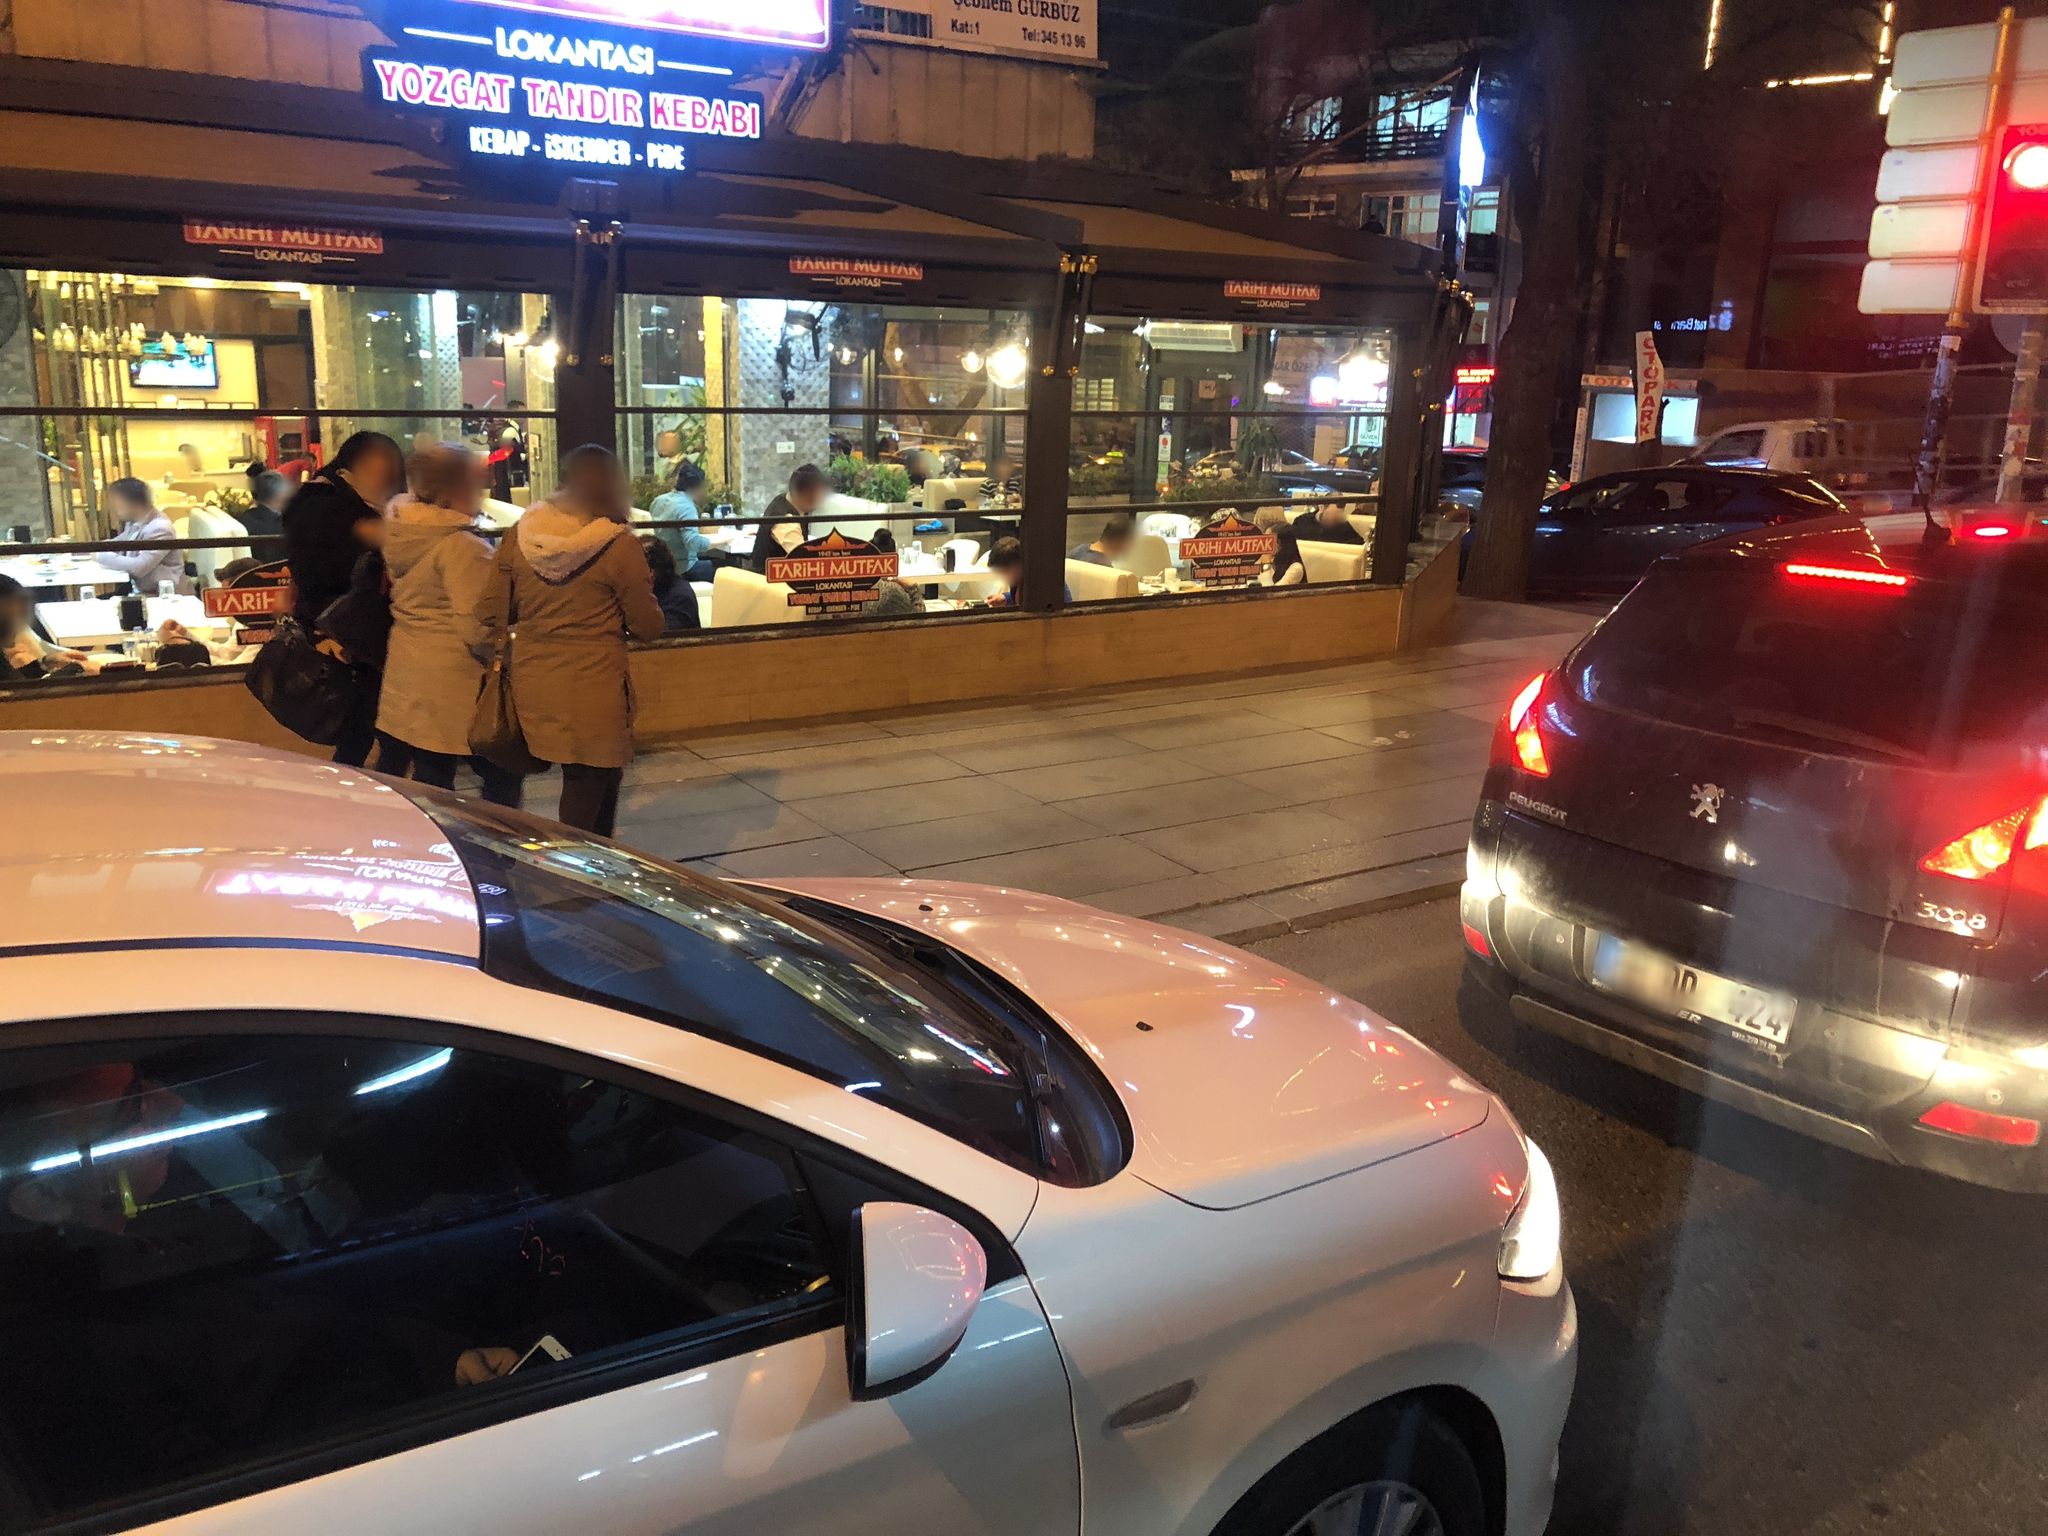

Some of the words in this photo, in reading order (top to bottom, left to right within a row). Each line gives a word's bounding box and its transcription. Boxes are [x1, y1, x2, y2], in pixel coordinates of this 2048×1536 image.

[1061, 34, 1073, 47] 13
[496, 27, 655, 76] LOKANTASI
[373, 59, 512, 113] YOZGAT
[522, 77, 644, 128] TANDIR
[649, 96, 761, 139] KEBABI
[469, 126, 531, 155] KEBAP
[254, 249, 323, 263] LOKANTASI
[853, 260, 920, 276] MUTFAK
[836, 276, 881, 287] LOKANTASI
[1270, 284, 1317, 297] MUTFAK
[1639, 337, 1659, 436] OTOPARK
[1225, 538, 1272, 554] MUTFAK
[830, 558, 894, 576] MUTFAK
[815, 582, 853, 591] LOKANTASI
[1509, 791, 1568, 821] PEUGEOT
[1917, 902, 1987, 930] 3008
